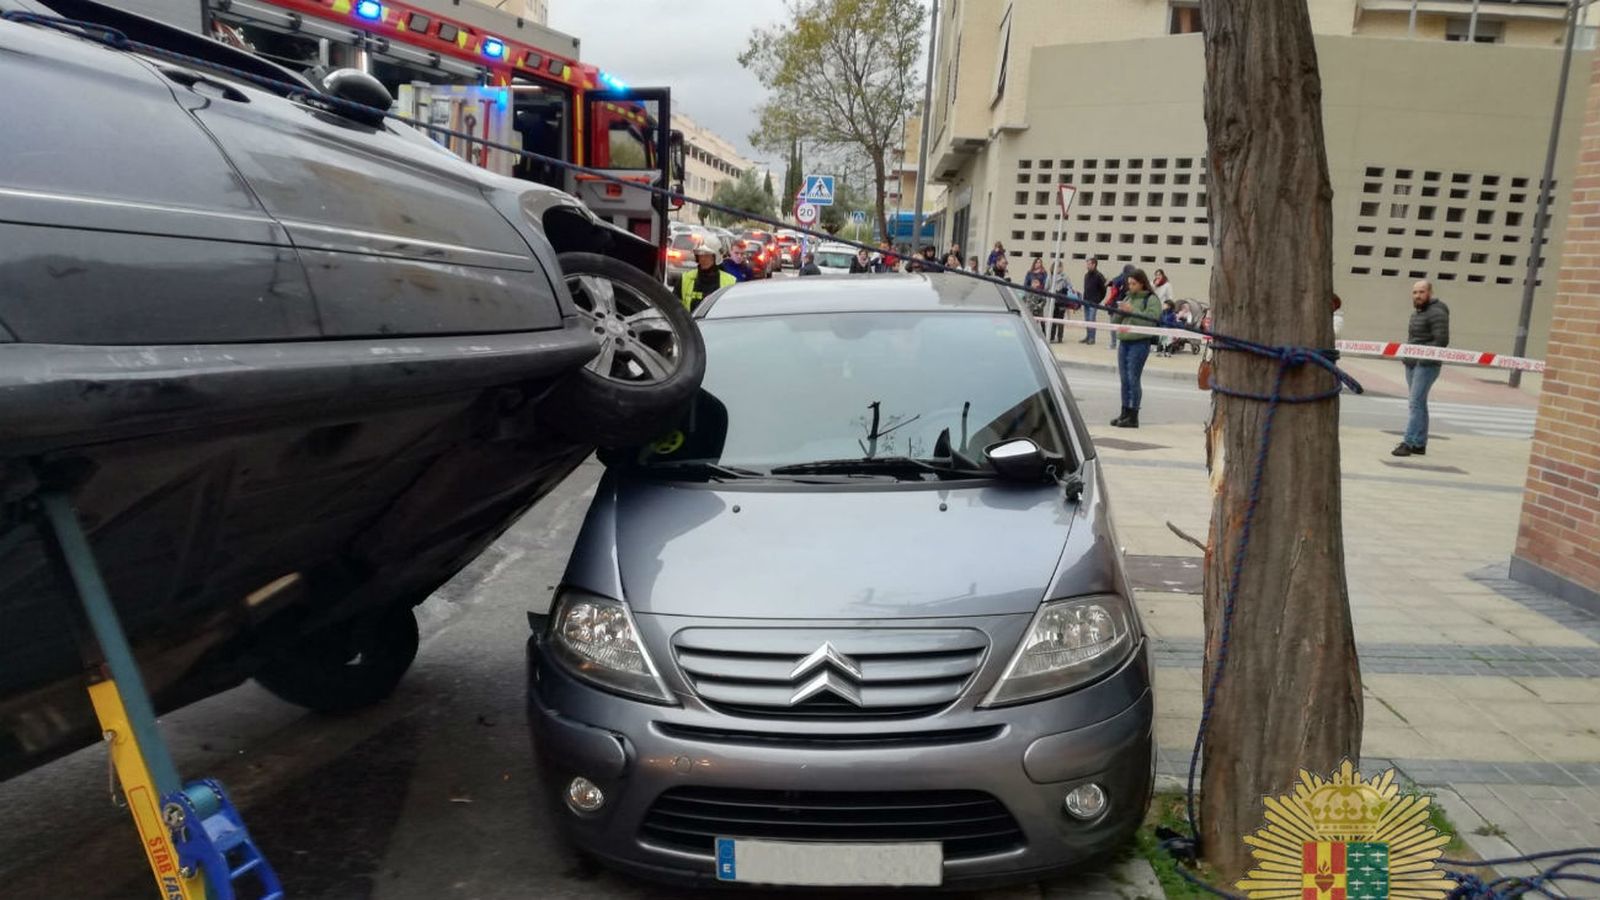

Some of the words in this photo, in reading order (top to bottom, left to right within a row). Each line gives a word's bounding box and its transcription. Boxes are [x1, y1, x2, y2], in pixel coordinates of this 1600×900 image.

[799, 207, 813, 217] 20
[1404, 346, 1425, 356] PASAR
[1425, 347, 1436, 357] NO
[1439, 349, 1475, 362] BOMBEROS
[149, 836, 173, 874] STAB
[722, 863, 731, 873] E
